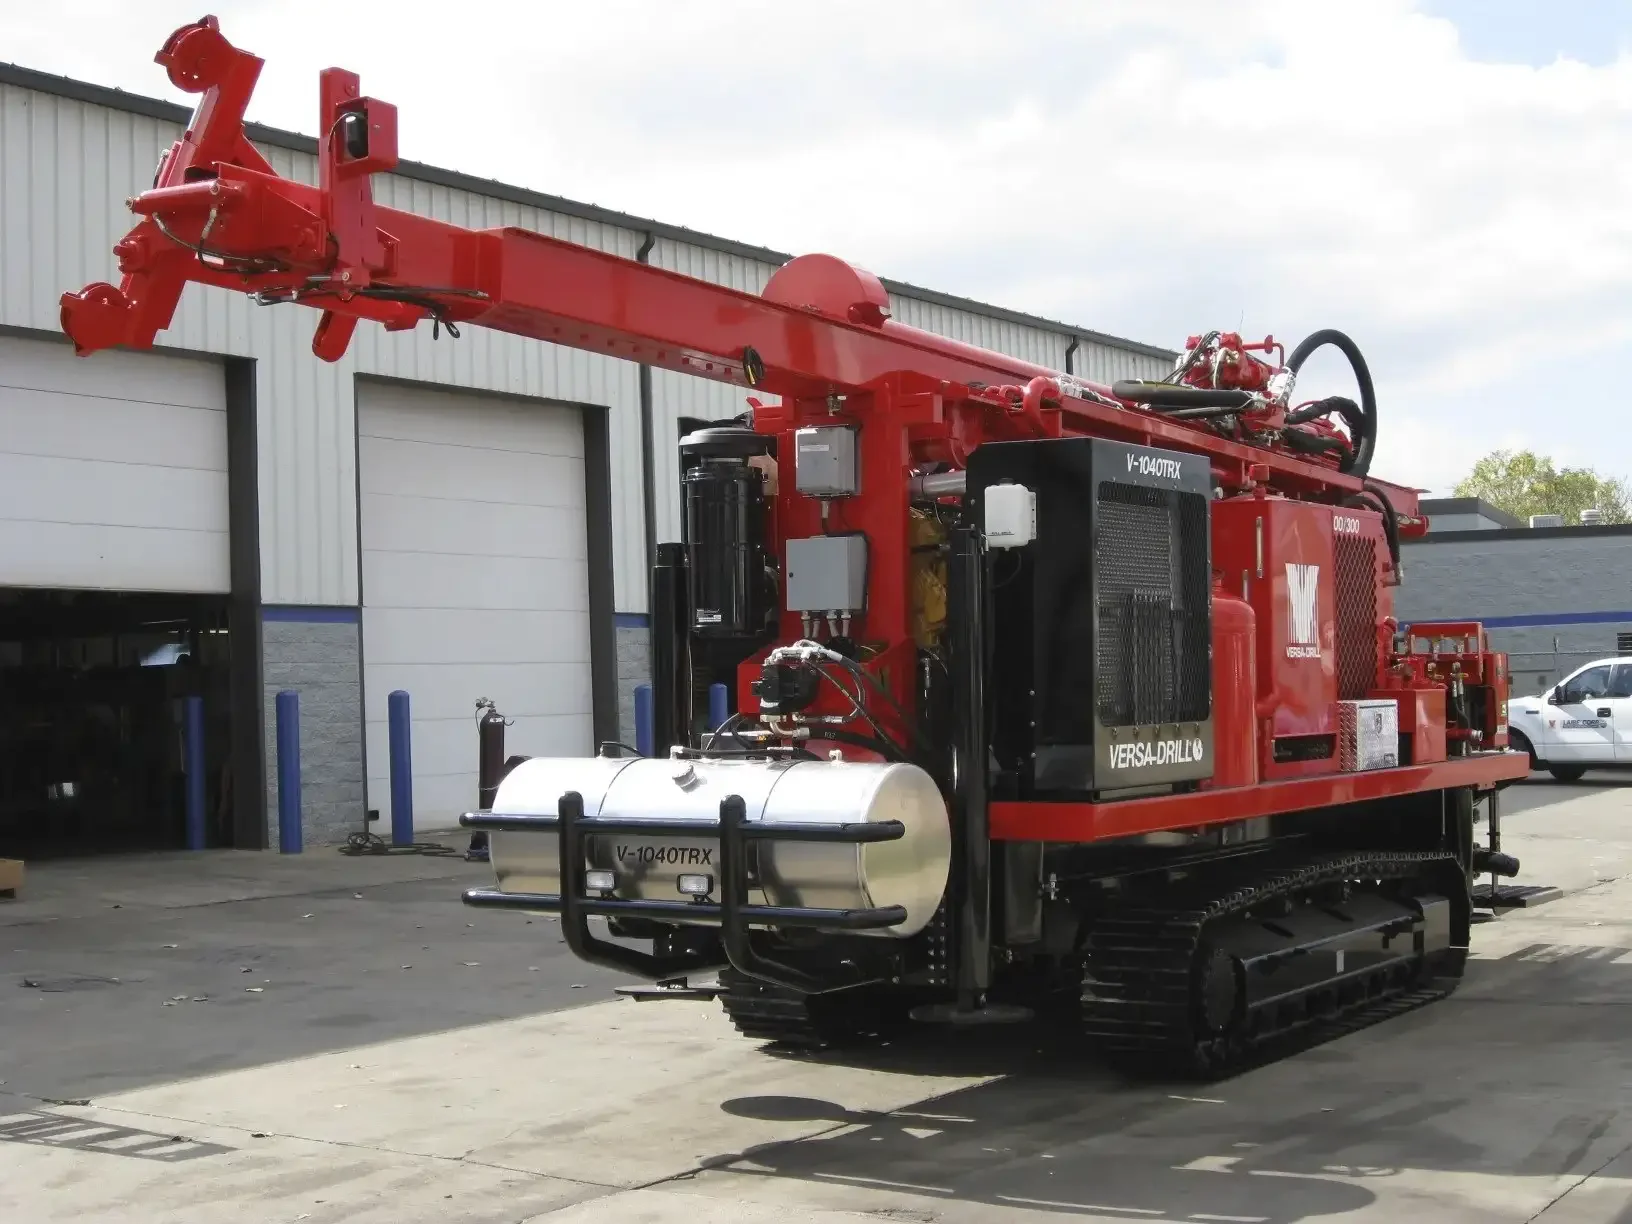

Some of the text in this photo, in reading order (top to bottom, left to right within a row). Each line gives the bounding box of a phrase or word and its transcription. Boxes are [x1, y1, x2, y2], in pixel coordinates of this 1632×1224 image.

[1127, 453, 1181, 479] V-1040TRX
[1286, 646, 1321, 658] VERSA-DRILL
[1109, 739, 1193, 769] VERSA-DRILL
[616, 845, 713, 865] V-1040TRX
